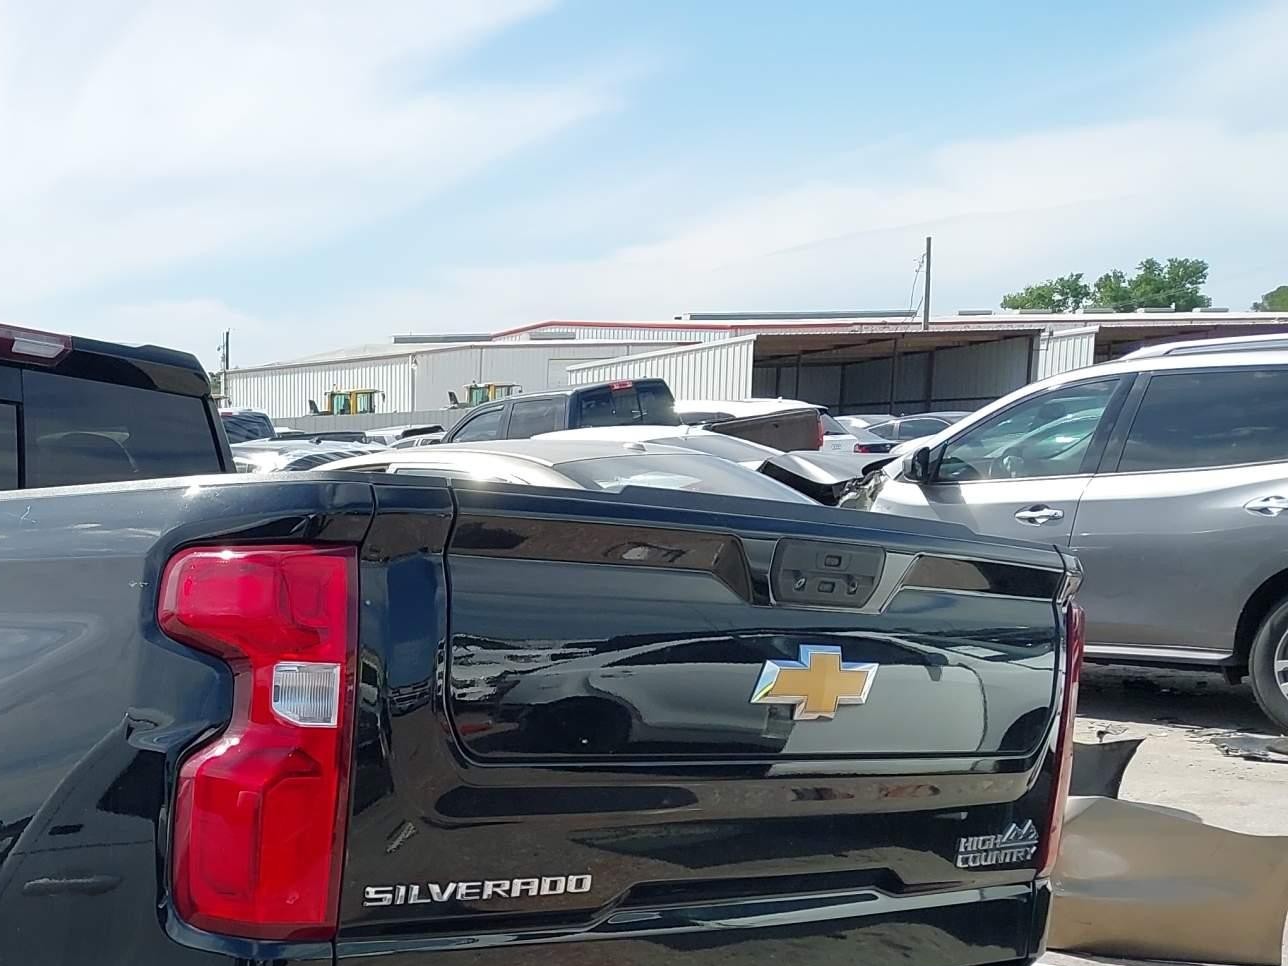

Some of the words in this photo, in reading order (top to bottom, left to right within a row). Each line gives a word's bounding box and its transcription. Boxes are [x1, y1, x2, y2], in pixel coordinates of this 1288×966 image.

[958, 834, 1004, 852] HIGH
[956, 846, 1038, 868] COUNTRY
[362, 874, 593, 907] SILVERADO
